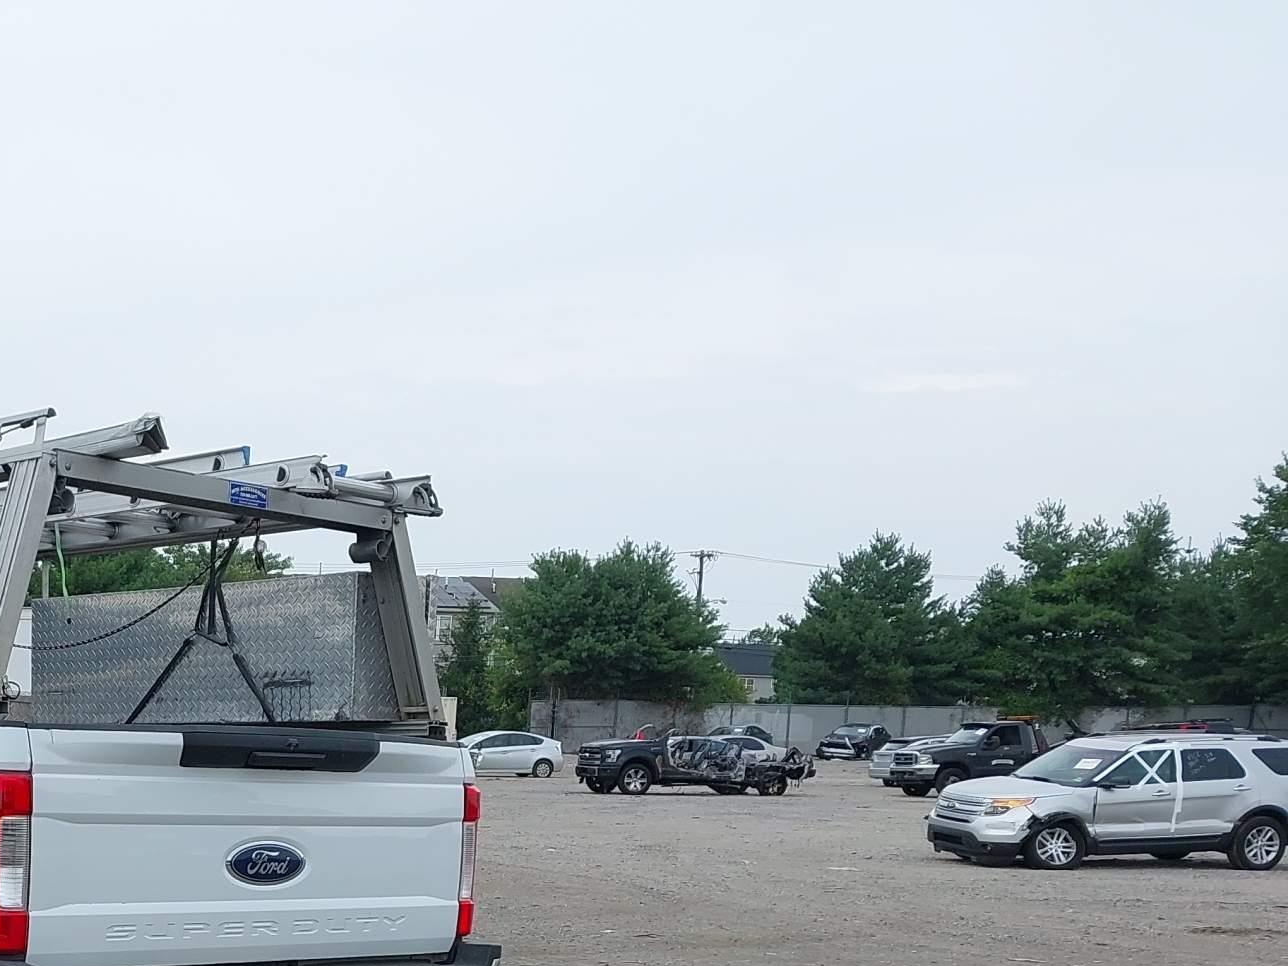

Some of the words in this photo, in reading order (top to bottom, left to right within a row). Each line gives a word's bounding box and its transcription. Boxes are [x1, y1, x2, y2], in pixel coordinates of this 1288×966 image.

[247, 849, 291, 875] Ford
[105, 920, 279, 942] SUPER
[292, 915, 406, 935] DUTY
